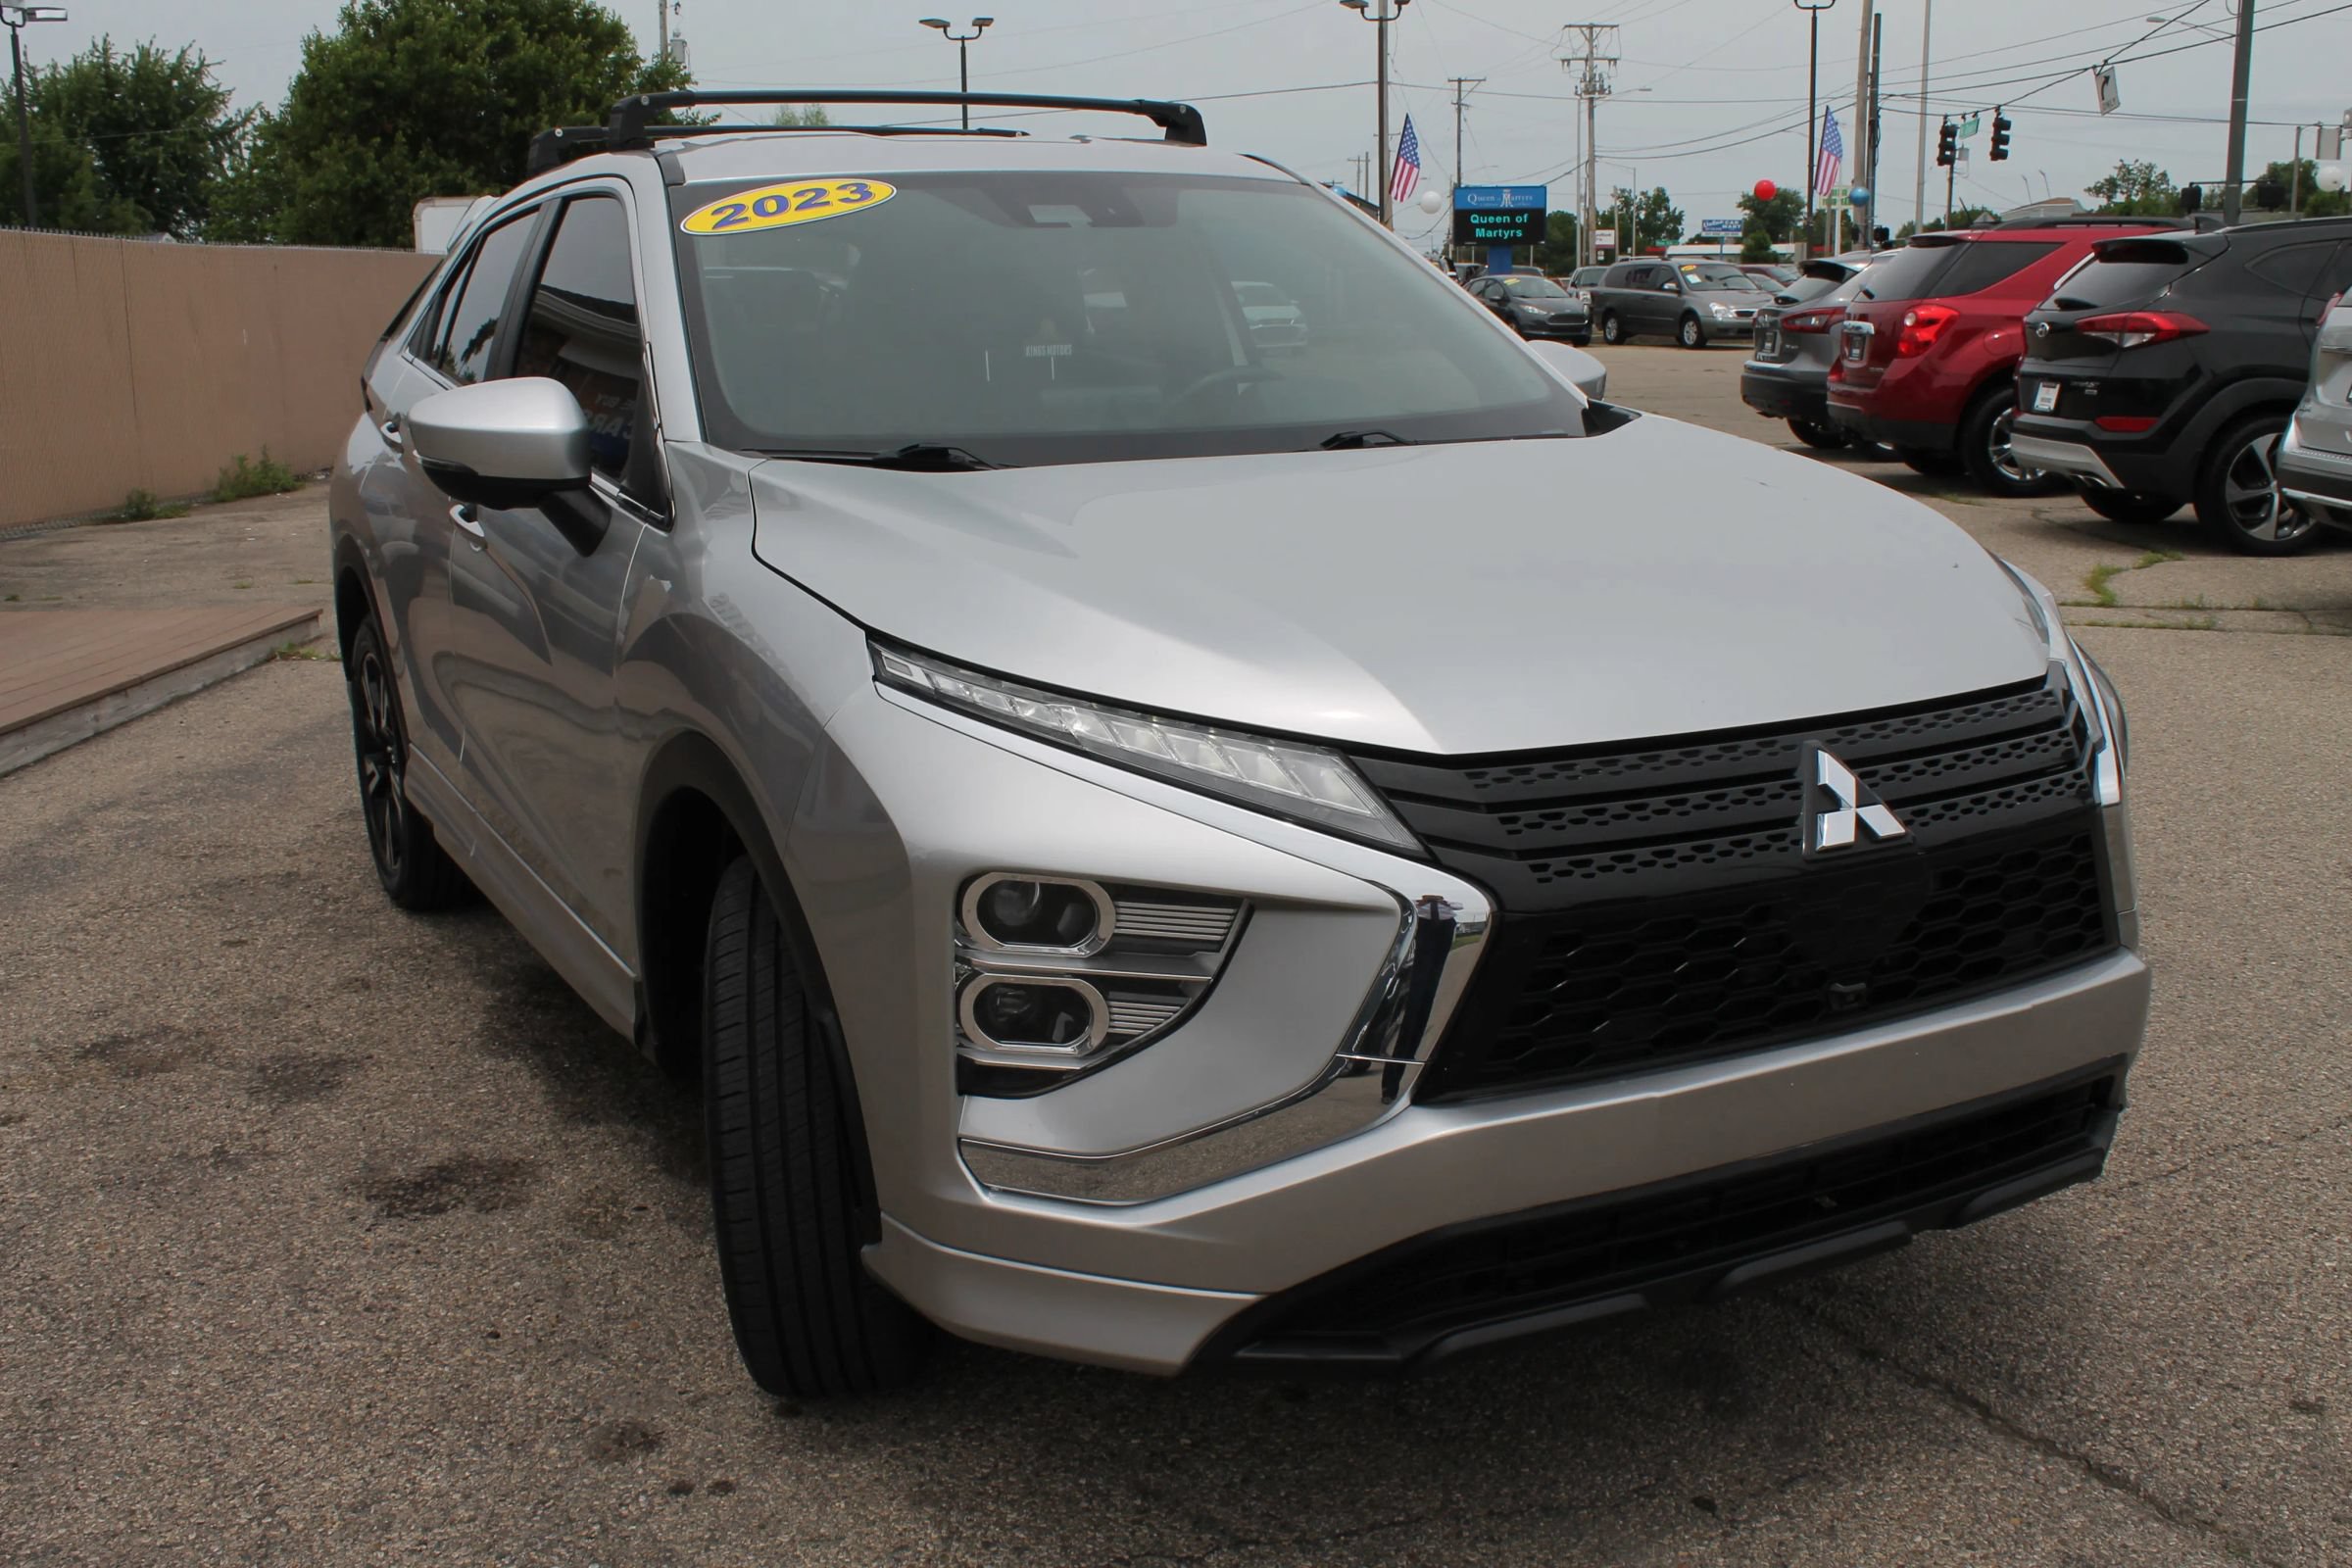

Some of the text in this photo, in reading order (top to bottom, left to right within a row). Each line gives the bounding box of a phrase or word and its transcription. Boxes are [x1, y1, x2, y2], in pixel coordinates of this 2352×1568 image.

[710, 182, 875, 229] 2023
[1470, 214, 1529, 223] Queen of
[1475, 227, 1523, 239] Martyrs
